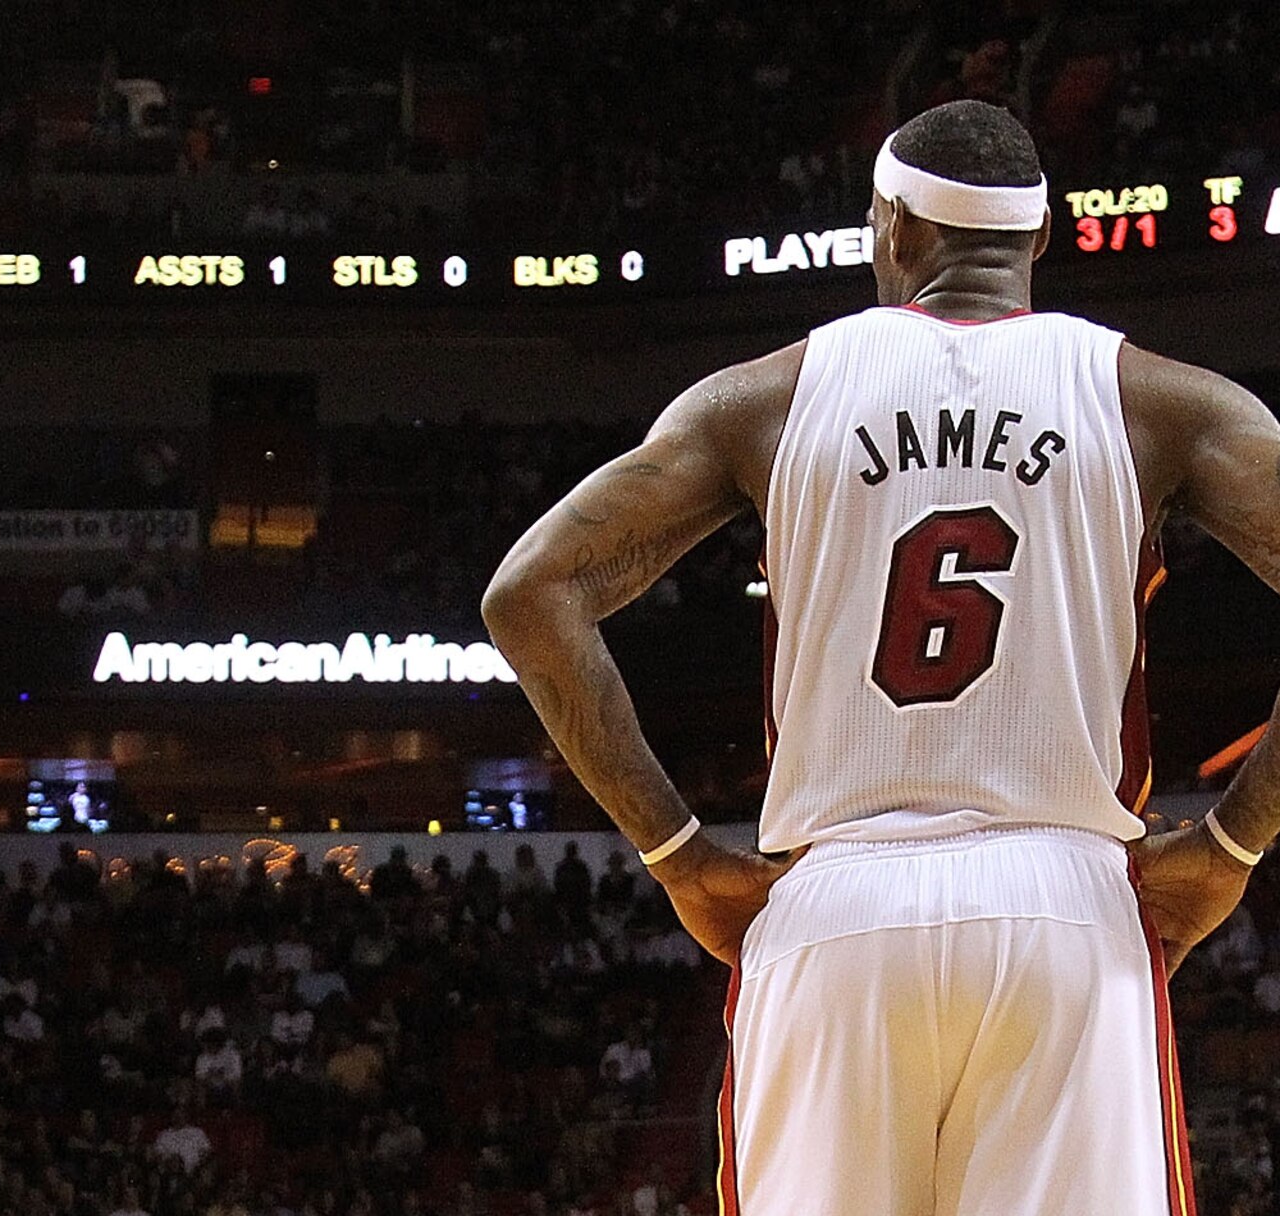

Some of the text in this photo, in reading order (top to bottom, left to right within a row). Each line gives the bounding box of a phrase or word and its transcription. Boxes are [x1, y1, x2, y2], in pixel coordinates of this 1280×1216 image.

[1204, 177, 1242, 204] TF
[1210, 206, 1237, 241] 3
[70, 256, 85, 283] 1
[135, 256, 243, 286] ASSTS
[269, 256, 285, 284] 1
[334, 256, 417, 286] STLS
[444, 256, 466, 286] 0
[514, 254, 598, 286] BLKS
[622, 251, 643, 280] 0
[854, 409, 1066, 486] JAMES
[868, 503, 1022, 708] 6
